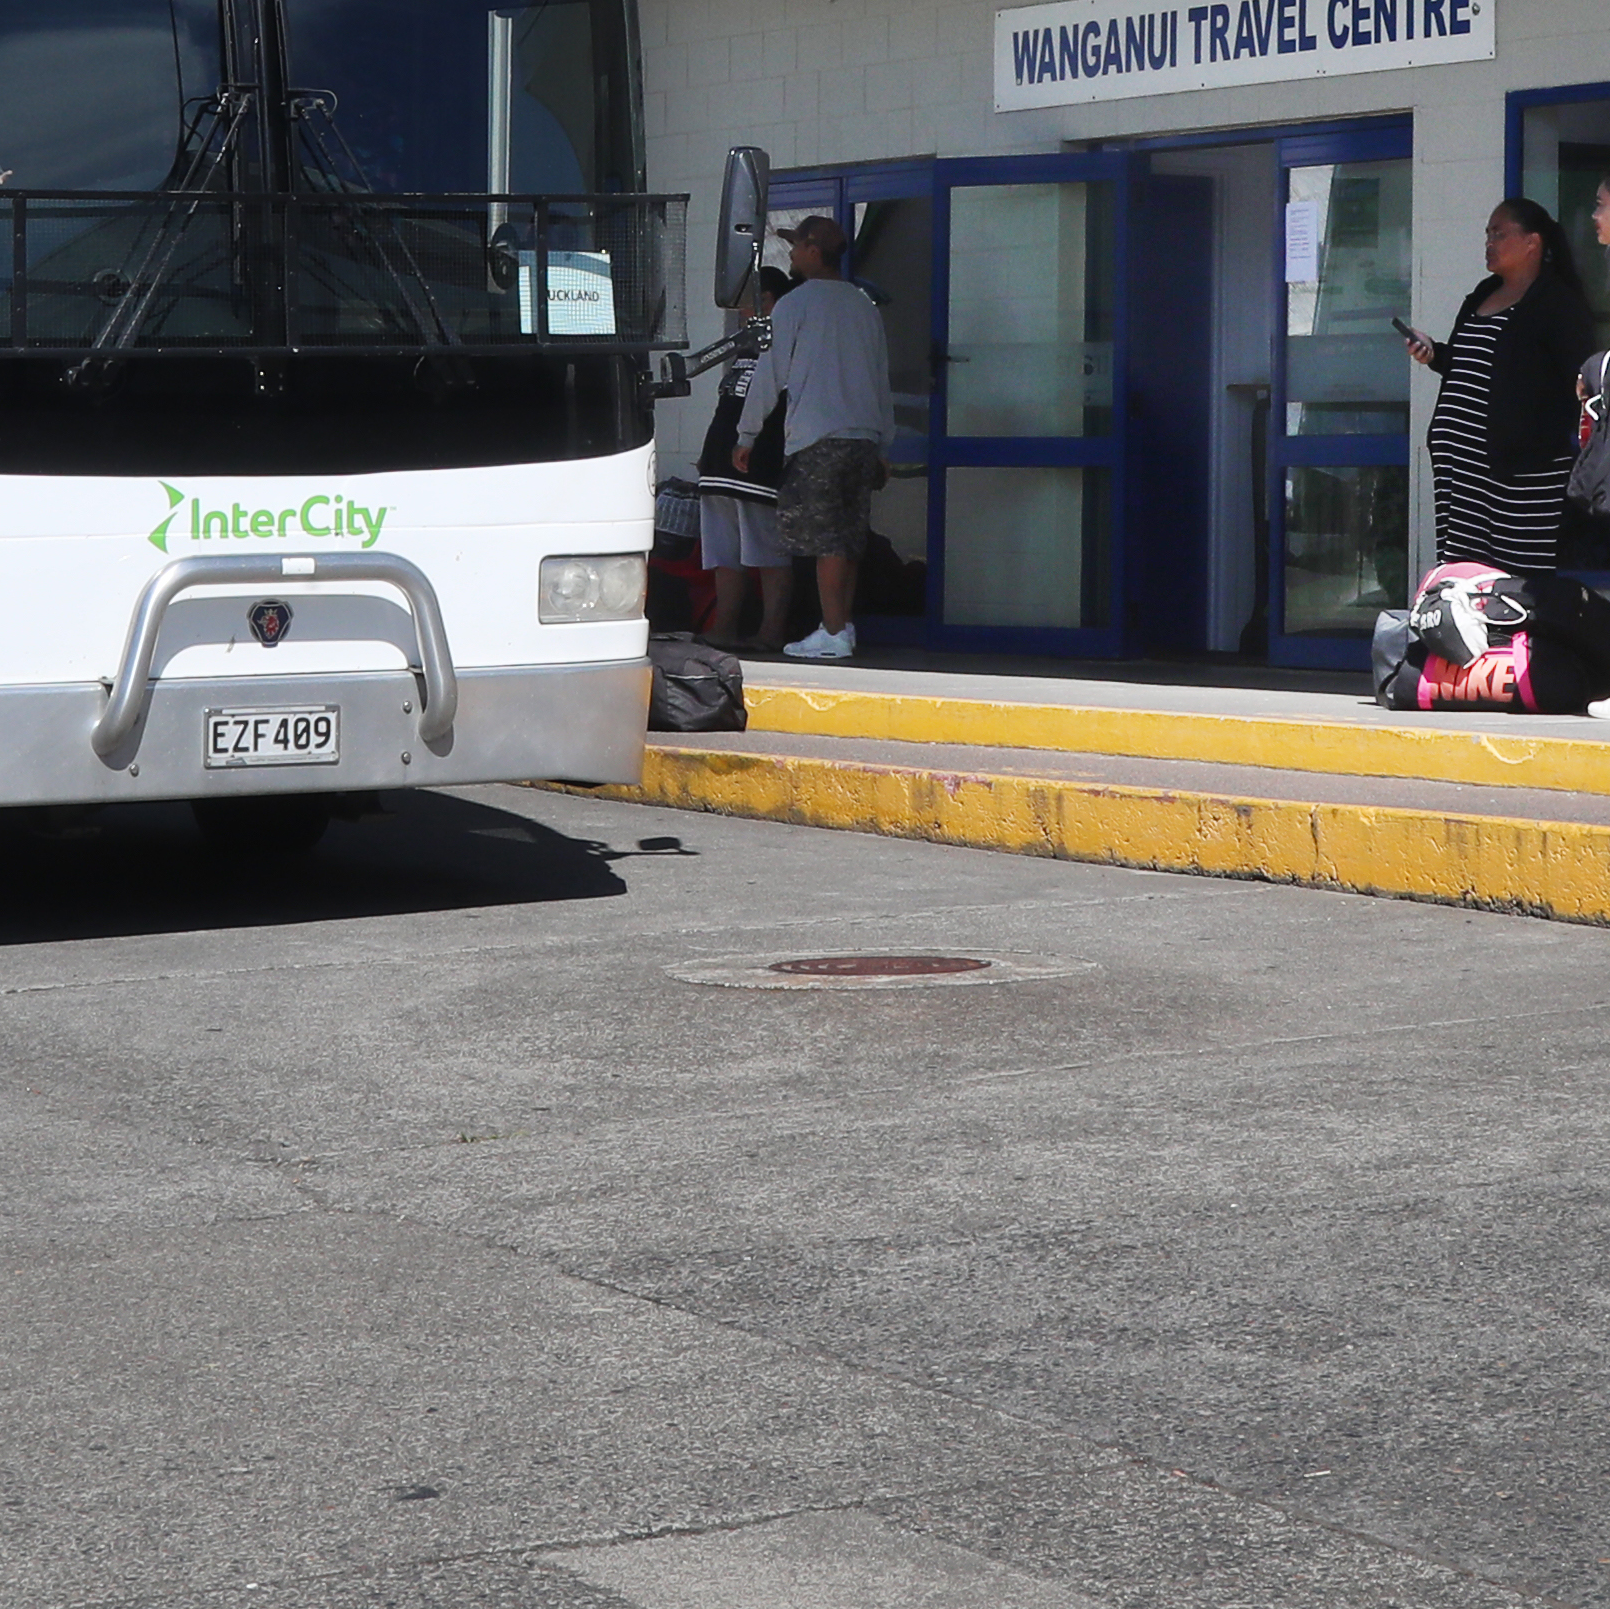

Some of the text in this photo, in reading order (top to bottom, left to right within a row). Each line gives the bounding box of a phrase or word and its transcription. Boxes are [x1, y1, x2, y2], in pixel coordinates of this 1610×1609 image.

[1012, 10, 1178, 86] WANGANUI
[547, 289, 600, 302] UCKLAND
[191, 494, 388, 549] InterCity
[1431, 655, 1515, 702] NIKE
[212, 716, 331, 754] EZF409
